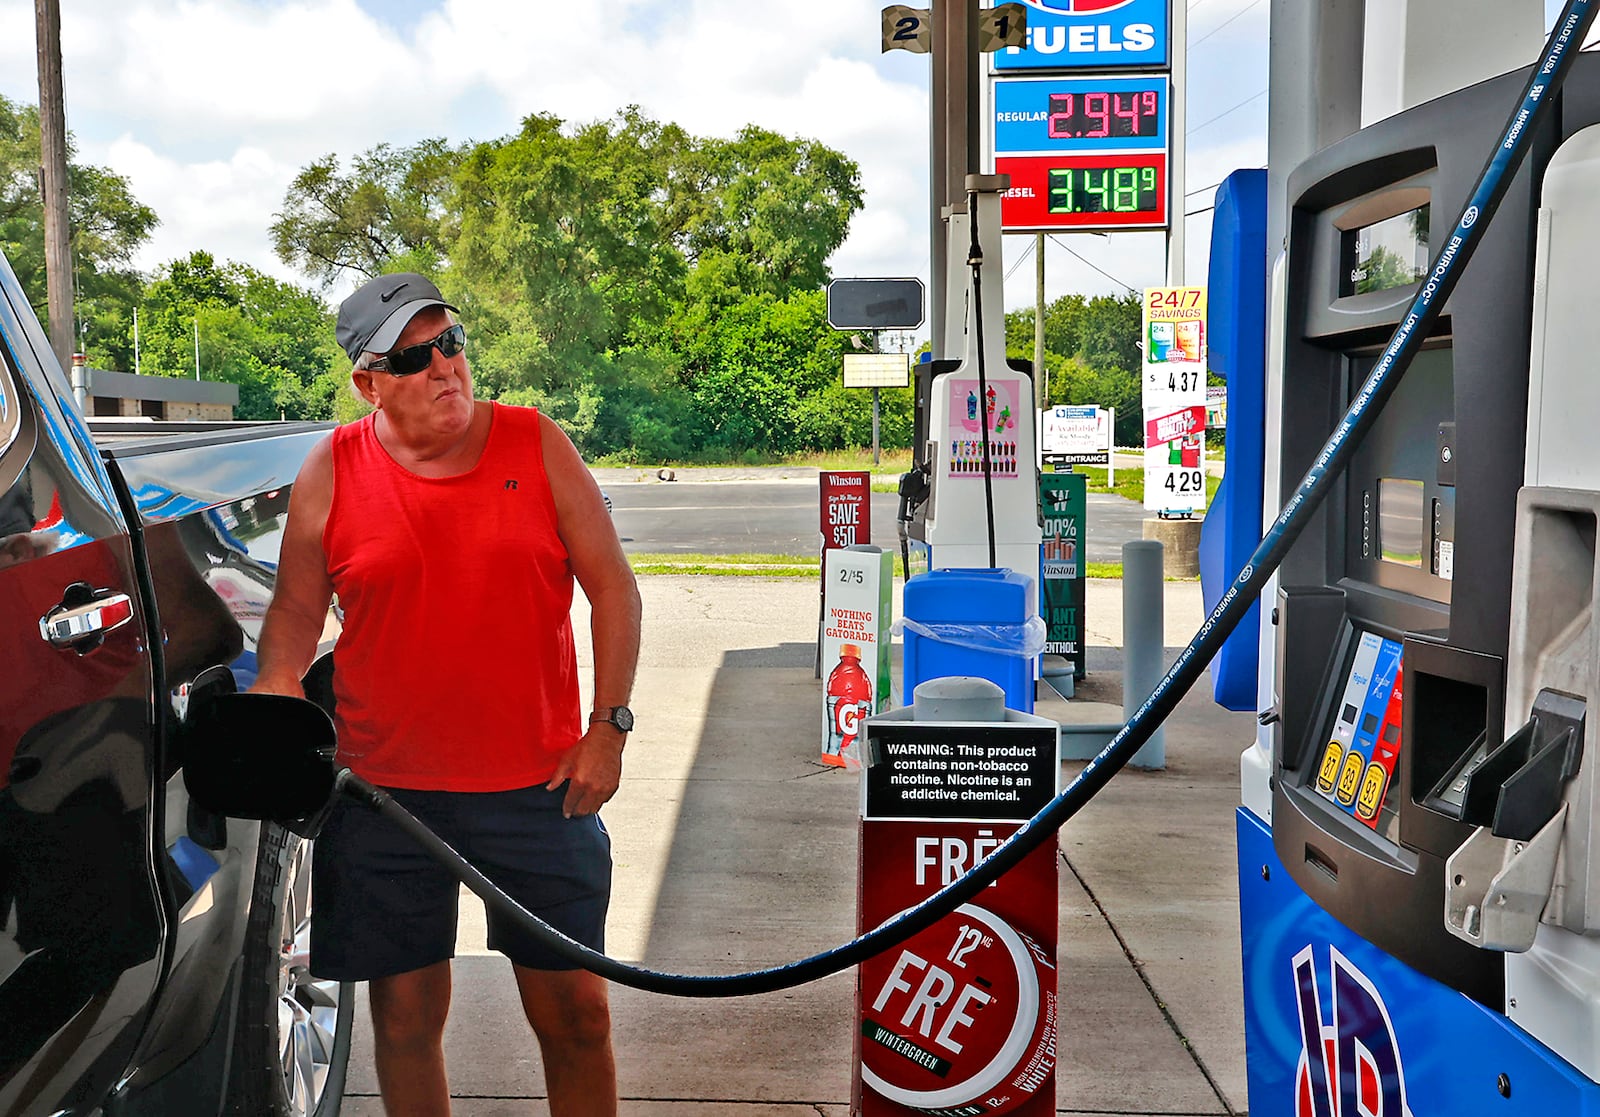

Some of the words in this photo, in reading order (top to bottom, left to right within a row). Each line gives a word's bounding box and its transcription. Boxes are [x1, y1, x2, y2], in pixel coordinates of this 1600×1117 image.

[893, 17, 920, 41] 2
[993, 15, 1010, 39] 1
[1558, 13, 1579, 43] MADE
[1552, 43, 1566, 55] IN
[1541, 55, 1558, 75] USA
[997, 112, 1048, 122] REGULAR
[1000, 187, 1035, 198] IESEL
[1150, 291, 1201, 308] 24/7
[1150, 309, 1201, 319] SAVINGS
[1401, 313, 1418, 332] LOW
[1389, 331, 1409, 357] PERM
[1365, 356, 1393, 395] GASOLINE
[1351, 394, 1369, 417] HOSE
[1334, 421, 1352, 447] MADE
[1065, 455, 1107, 463] ENTRANCE
[829, 475, 862, 486] Winston
[829, 503, 860, 525] SAVE
[1043, 518, 1077, 536] 00%
[831, 608, 872, 621] NOTHING
[837, 619, 865, 631] BEATS
[826, 628, 876, 642] GATORADE.
[1044, 641, 1077, 654] ENTHOL
[838, 703, 859, 735] G
[887, 744, 954, 756] WARNING:
[957, 744, 984, 756] This
[987, 746, 1036, 758] product
[894, 759, 947, 770] contains
[950, 760, 1028, 771] non-tobacco
[1324, 756, 1336, 778] 87
[890, 774, 944, 785] nicotine.
[947, 775, 999, 786] Nicotine
[1001, 775, 1013, 786] is
[1015, 777, 1032, 786] an
[1343, 767, 1355, 791] 89
[901, 789, 958, 800] addictive
[961, 789, 1020, 801] chemical.
[1364, 780, 1376, 804] 93
[874, 1027, 938, 1070] WINTERGREEN
[1012, 1072, 1029, 1088] HIGH
[1024, 1041, 1048, 1074] STRENGTH
[1019, 1056, 1054, 1093] WHITE
